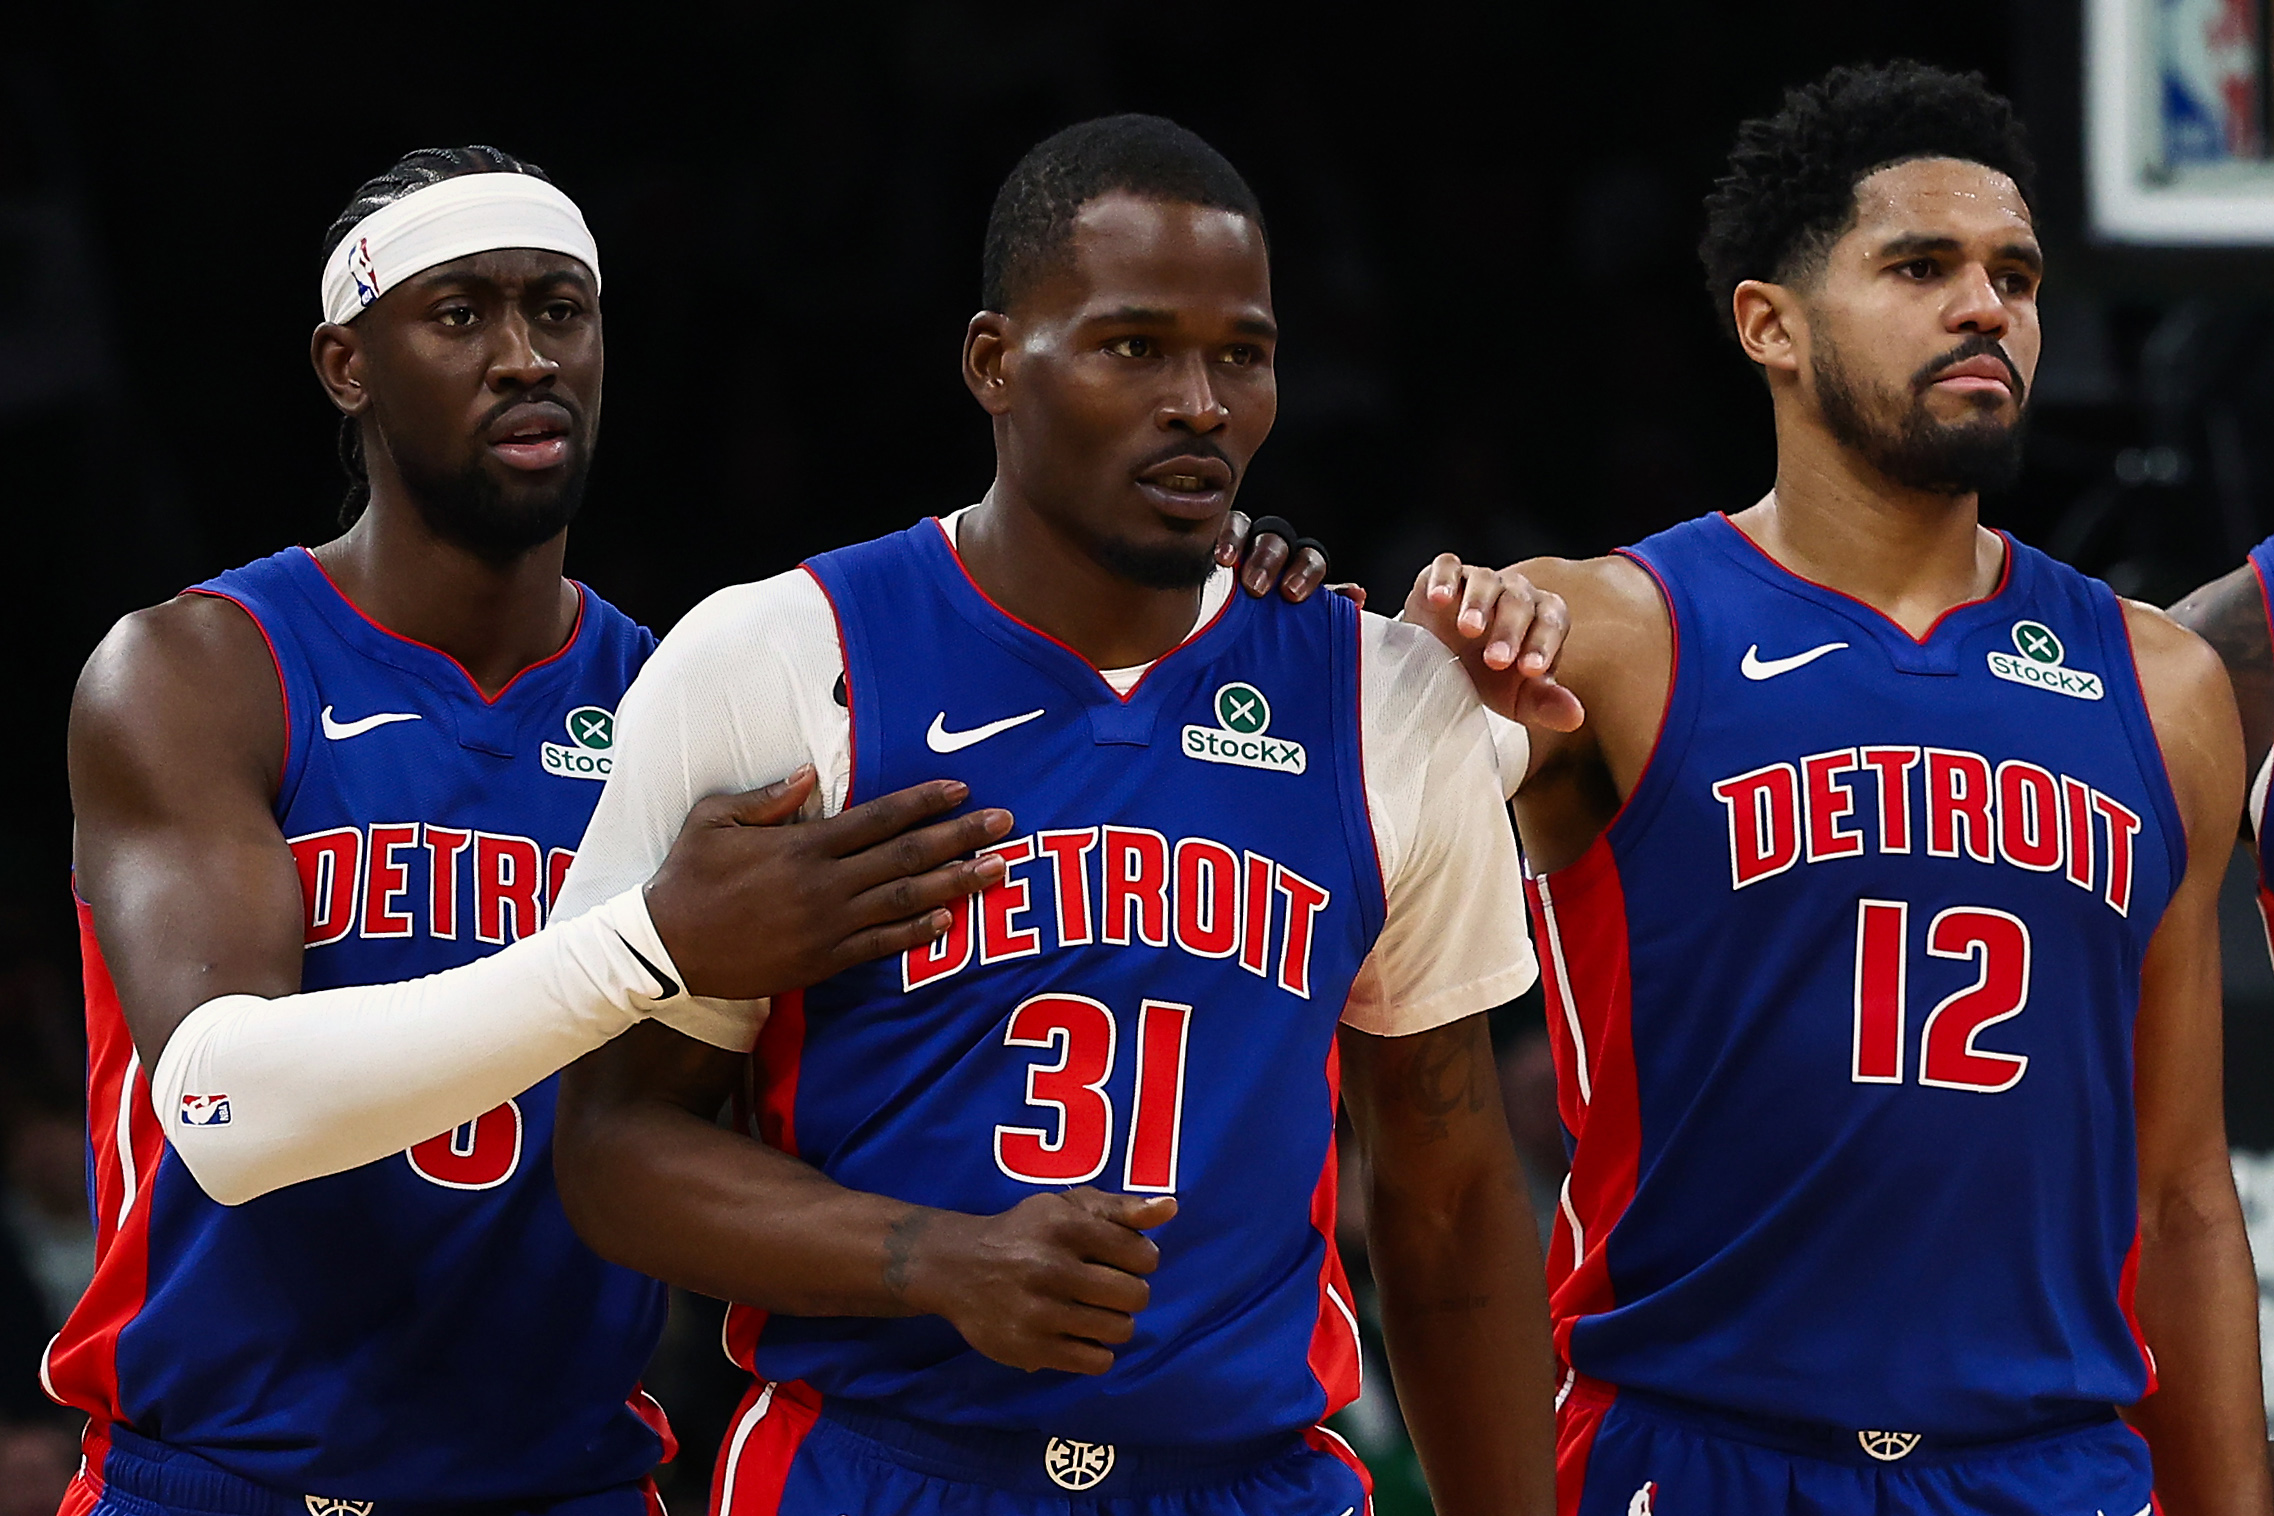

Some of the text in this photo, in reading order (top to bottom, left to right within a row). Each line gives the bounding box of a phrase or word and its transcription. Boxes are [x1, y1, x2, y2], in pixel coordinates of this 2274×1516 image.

[1187, 729, 1301, 769] StockX
[1993, 656, 2099, 696] StockX
[286, 821, 577, 949] DETR
[1712, 745, 2142, 918] DETROIT
[1852, 899, 2031, 1093] 12
[994, 992, 1193, 1194] 31
